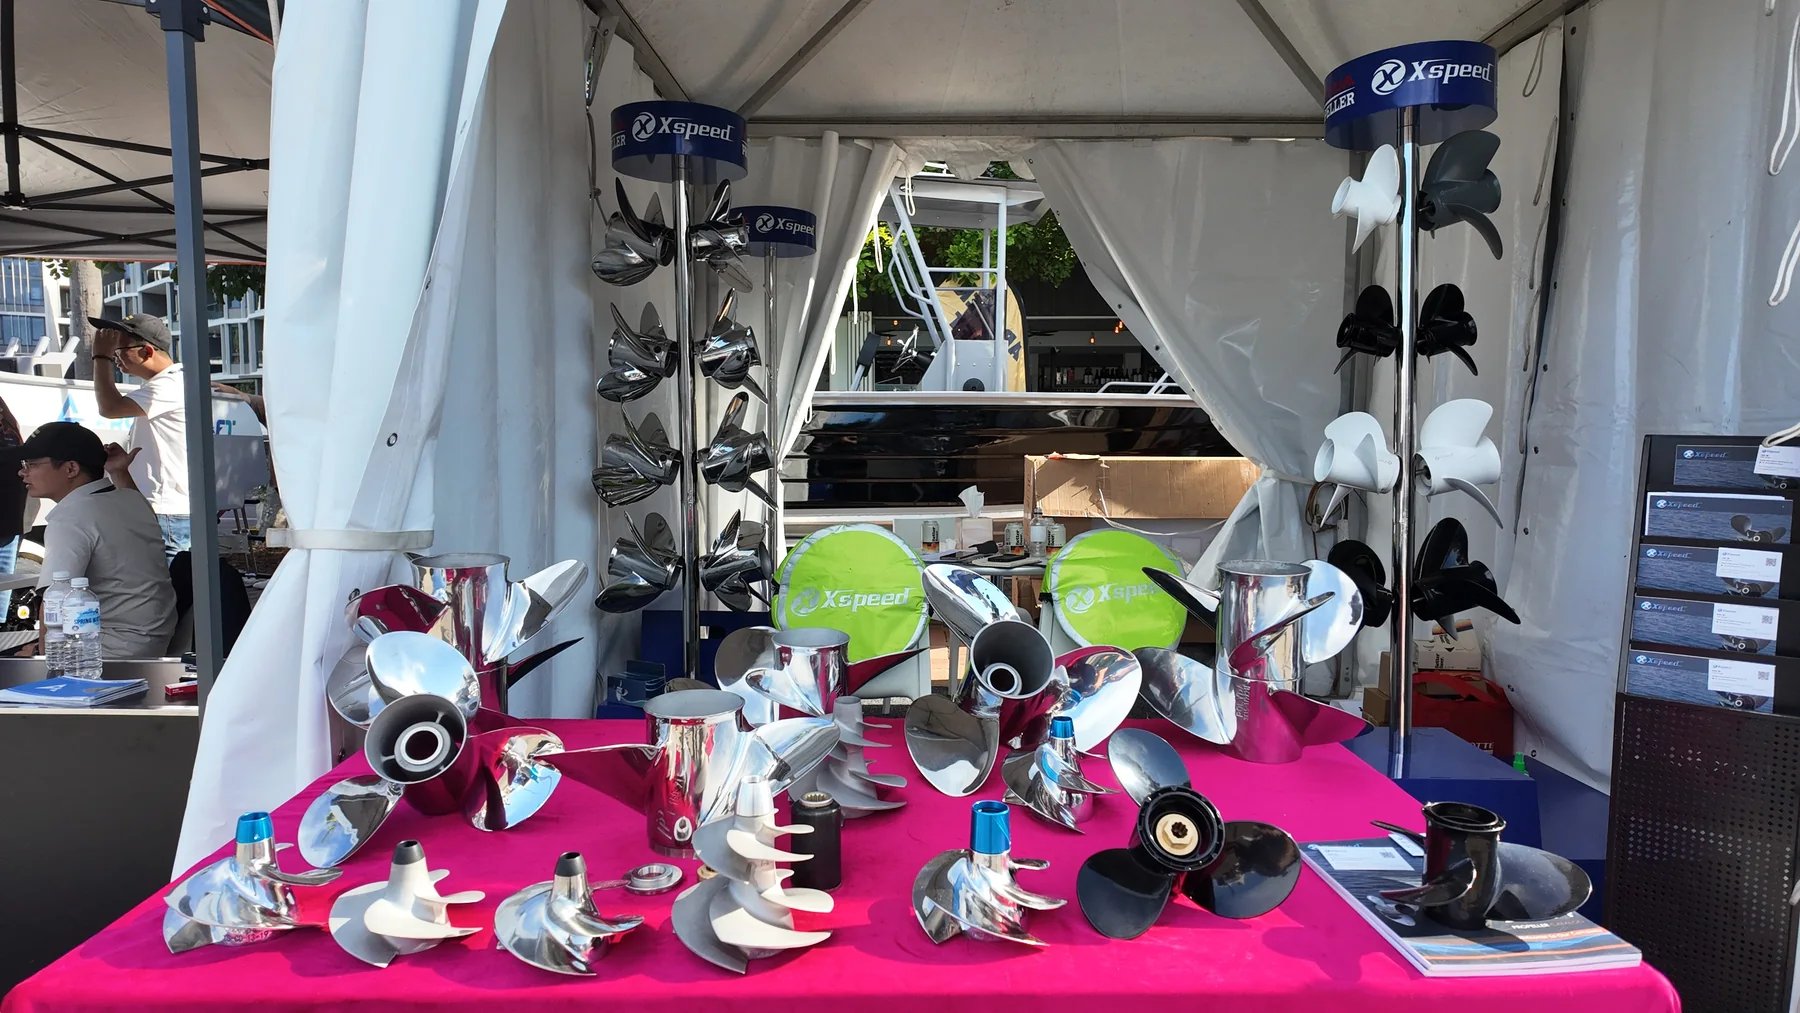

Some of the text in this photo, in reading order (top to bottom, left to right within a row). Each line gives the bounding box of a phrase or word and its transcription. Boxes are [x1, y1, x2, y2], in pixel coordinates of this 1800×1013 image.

[1407, 59, 1495, 85] Xspeed
[657, 116, 736, 142] Xspeed
[1694, 451, 1729, 459] Xspeed
[1666, 500, 1702, 509] Xspeed
[1656, 550, 1692, 559] Xspeed
[822, 588, 913, 613] Xspeed
[1651, 602, 1687, 612] Xspeed
[1646, 657, 1682, 667] Xspeed
